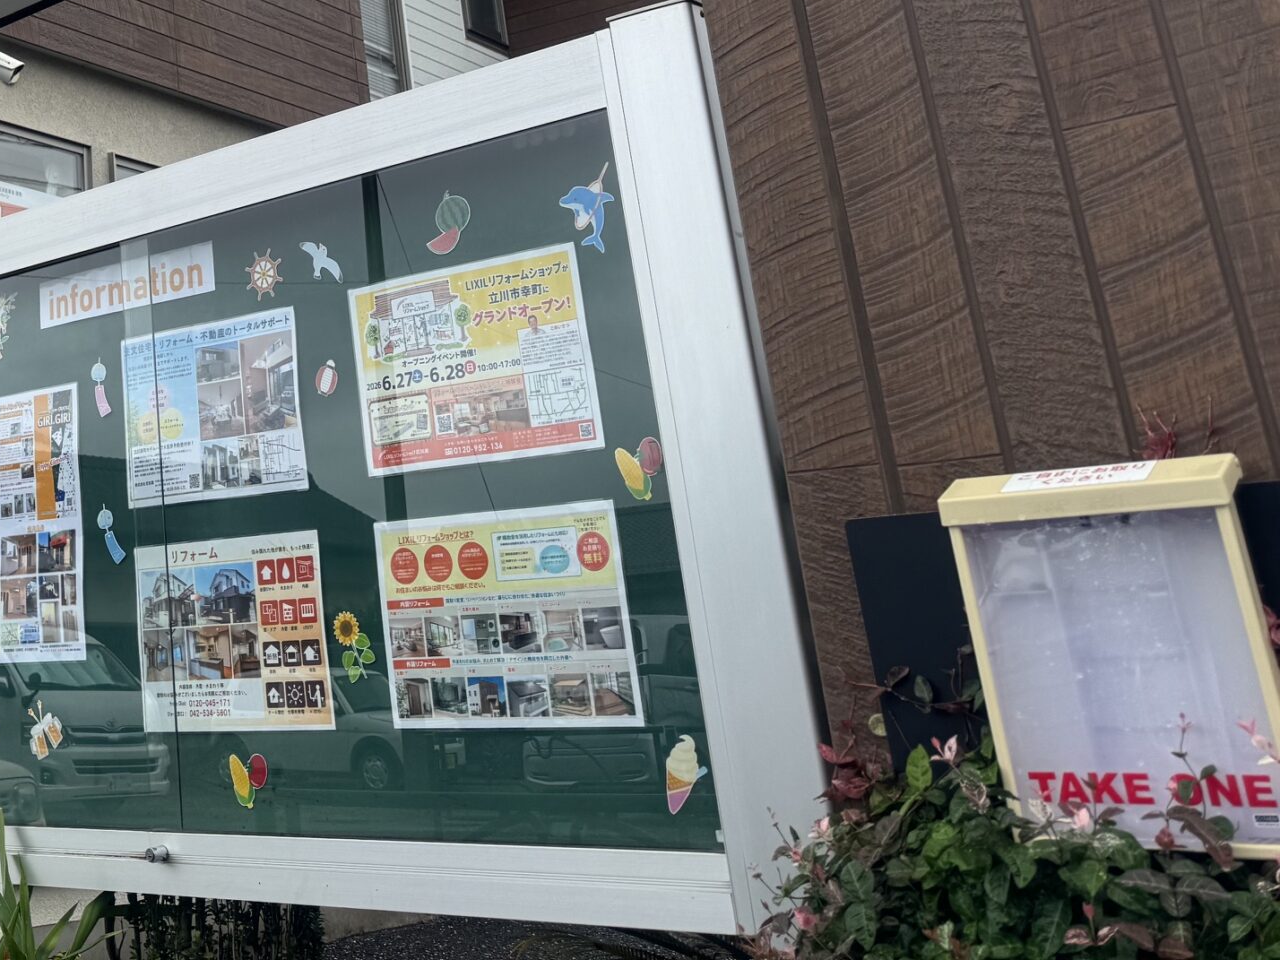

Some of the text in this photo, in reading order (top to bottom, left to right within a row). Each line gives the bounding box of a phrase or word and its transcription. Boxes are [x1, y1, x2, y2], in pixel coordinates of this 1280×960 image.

[48, 262, 204, 321] information
[465, 261, 569, 292] LIXILリフォームショップが
[488, 283, 550, 305] 立川市幸町に
[472, 296, 572, 327] グランドオープン!
[401, 349, 477, 368] オープニングイベント開催!
[366, 380, 382, 391] 2026
[477, 358, 521, 373] 10:00-17:00
[170, 546, 219, 564] リフォーム
[583, 552, 603, 564] 無料
[1027, 771, 1279, 808] TAKE ONE
